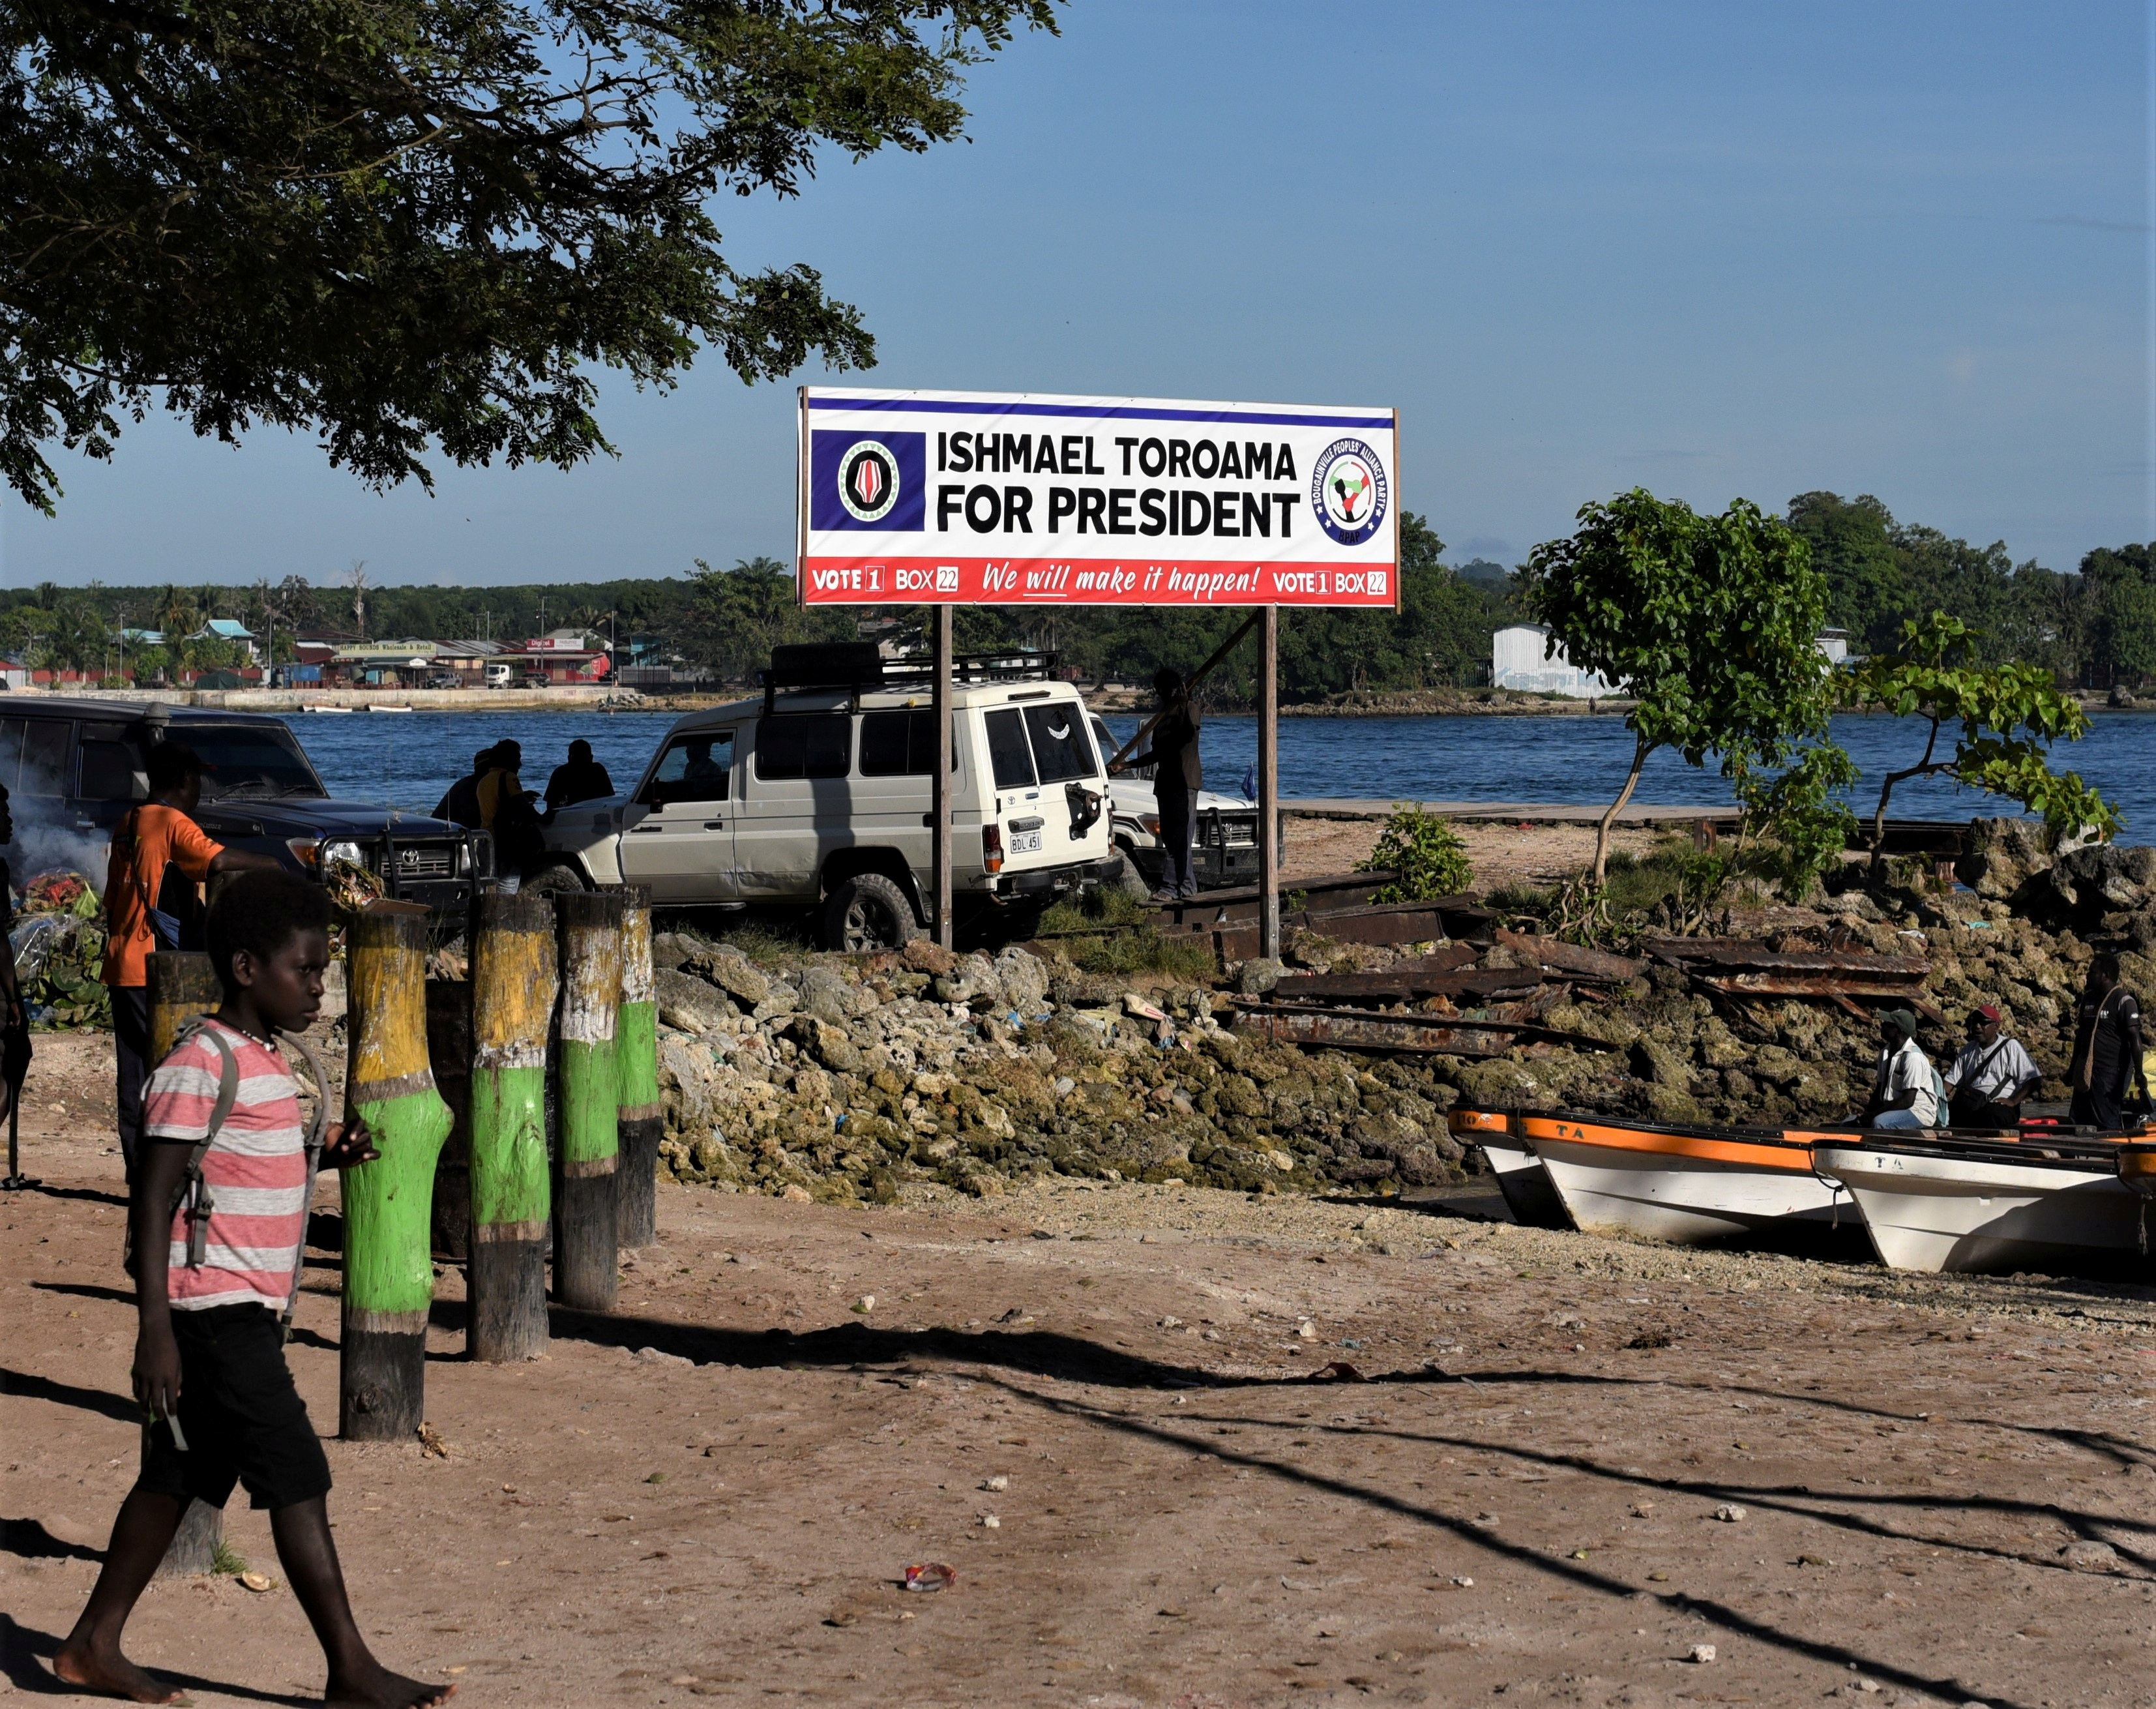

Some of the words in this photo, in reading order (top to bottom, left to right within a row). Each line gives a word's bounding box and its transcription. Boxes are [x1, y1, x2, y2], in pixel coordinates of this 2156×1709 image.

[938, 432, 1105, 475] ISHMAEL
[1115, 437, 1297, 481] TOROAMA
[1313, 450, 1335, 505] BOUGAINVILLE
[1333, 440, 1361, 456] PEOPLES'
[1359, 446, 1383, 482] ALLIANCE
[1376, 481, 1385, 509] PARTY
[938, 484, 1033, 533] FOR
[1048, 487, 1301, 539] PRESIDENT
[1338, 530, 1361, 544] BPAP
[812, 569, 861, 590] VOTE
[867, 567, 883, 591] 1
[896, 569, 934, 589] BOX
[938, 568, 958, 590] 22
[982, 562, 1017, 591] We
[1024, 565, 1071, 591] will
[1075, 565, 1136, 591] make
[1143, 565, 1164, 591] it
[1168, 566, 1261, 600] happen!
[1273, 571, 1314, 593] VOTE
[1317, 572, 1330, 593] 1
[1336, 572, 1365, 593] BOX
[1368, 573, 1385, 593] 22
[1012, 839, 1026, 851] BDL
[1029, 836, 1040, 849] 451
